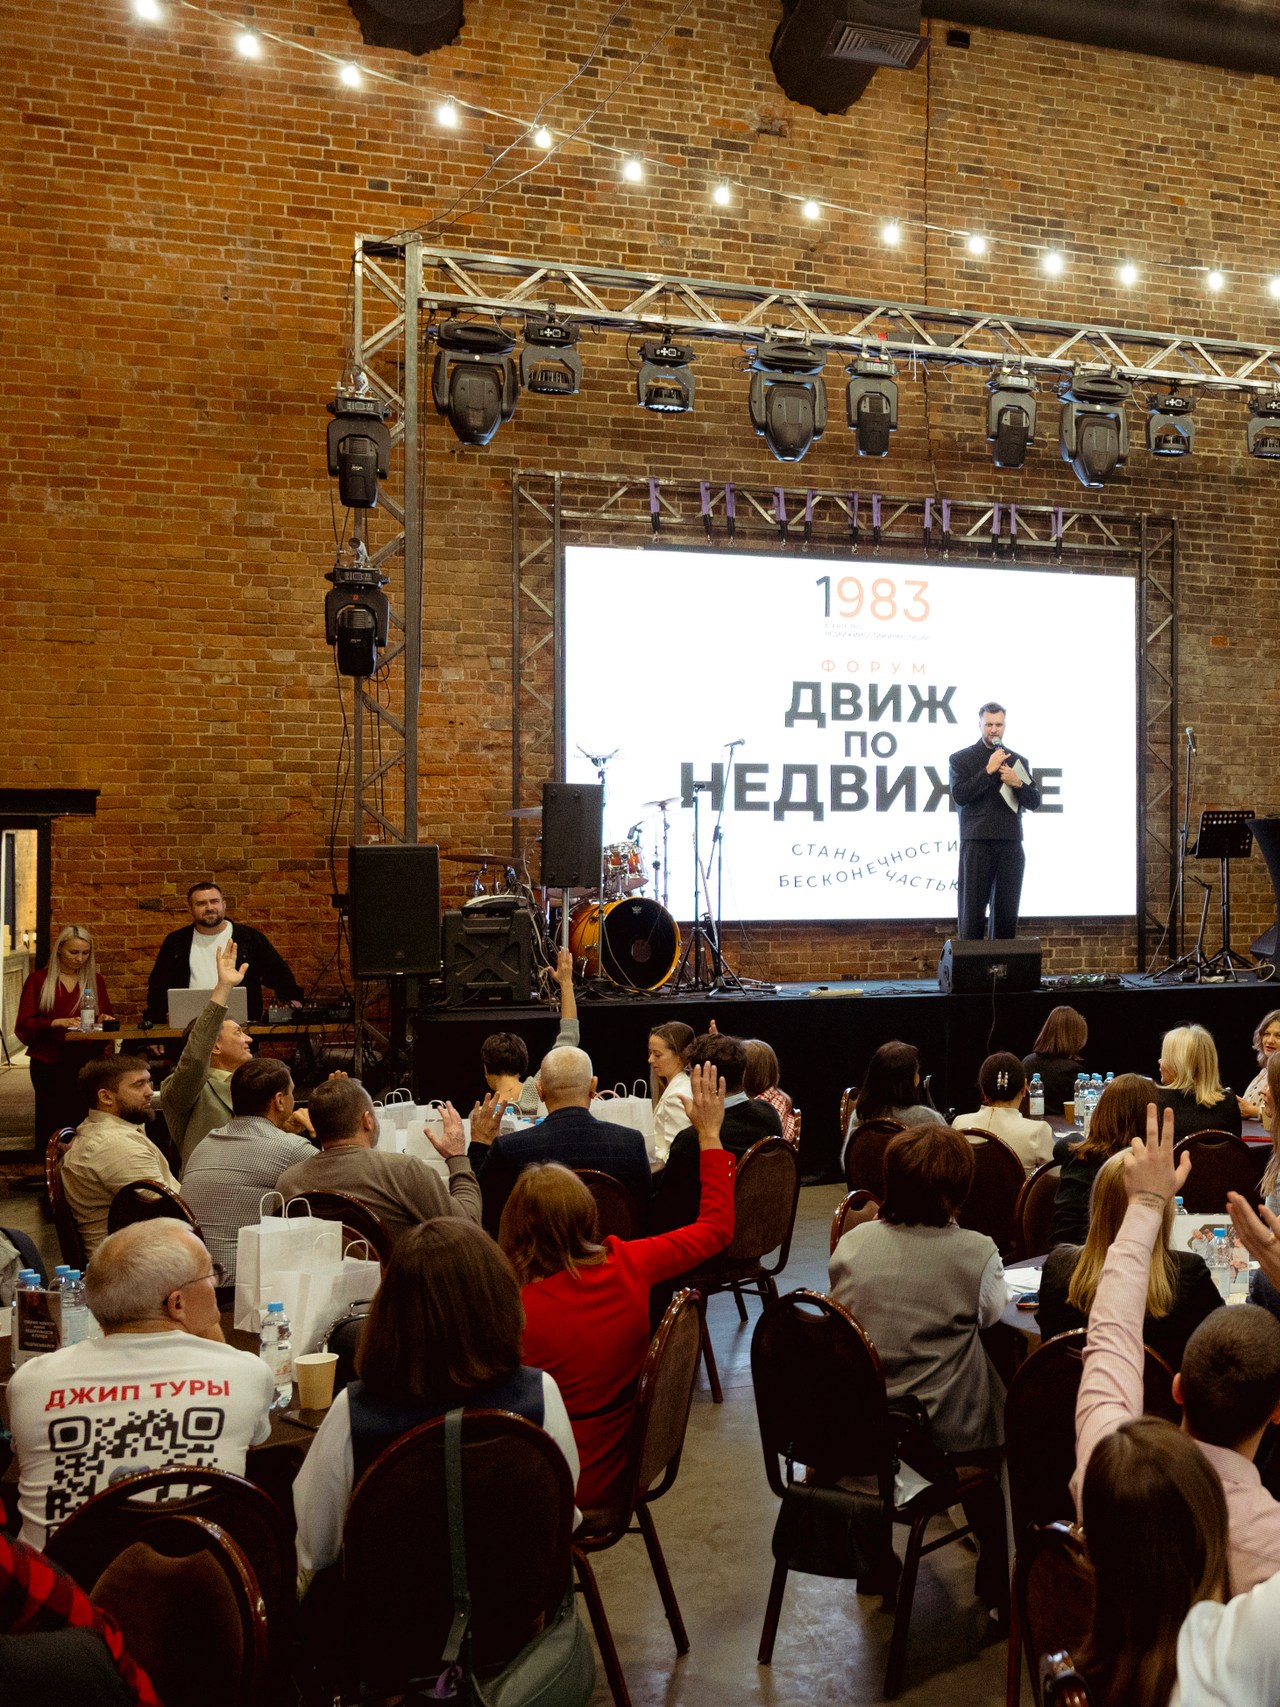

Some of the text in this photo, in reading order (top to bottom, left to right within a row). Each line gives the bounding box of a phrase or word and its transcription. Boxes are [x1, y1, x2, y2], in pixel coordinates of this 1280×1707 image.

[815, 575, 930, 622] 1983
[821, 659, 926, 675] ФОРУМ
[784, 680, 958, 729] ДВИЖ
[844, 730, 898, 759] ПО
[680, 761, 1064, 822] НЕДВИЖЕ
[779, 840, 958, 888] БЕСКОНЕЧНОСТИ
[791, 843, 861, 863] СТАНЬ
[44, 1379, 230, 1411] ДЖИП ТУРЫ
